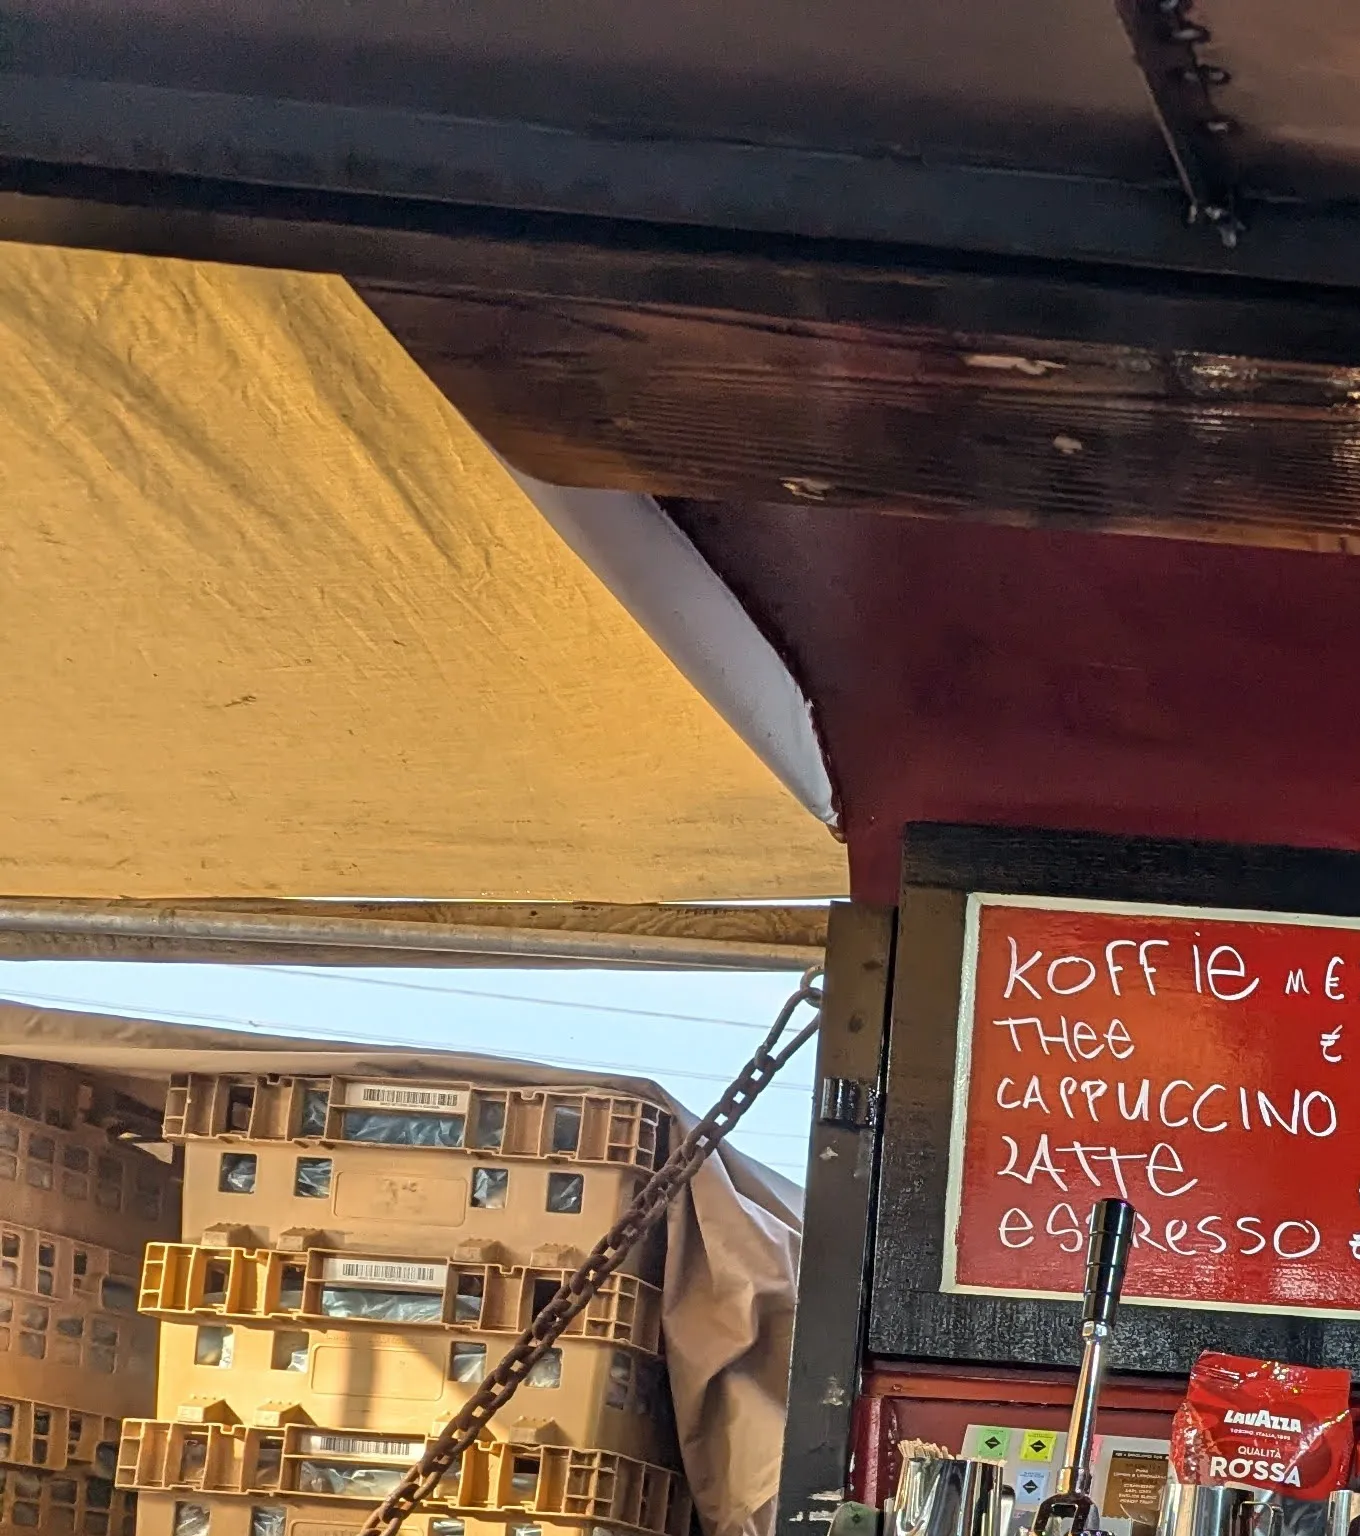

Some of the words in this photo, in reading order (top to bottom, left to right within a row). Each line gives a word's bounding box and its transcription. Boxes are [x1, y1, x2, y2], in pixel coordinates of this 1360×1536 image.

[997, 1075, 1338, 1137] CAPPUCCINO
[1224, 1410, 1301, 1434] LAVAZZA
[1209, 1455, 1301, 1488] ROSSA
